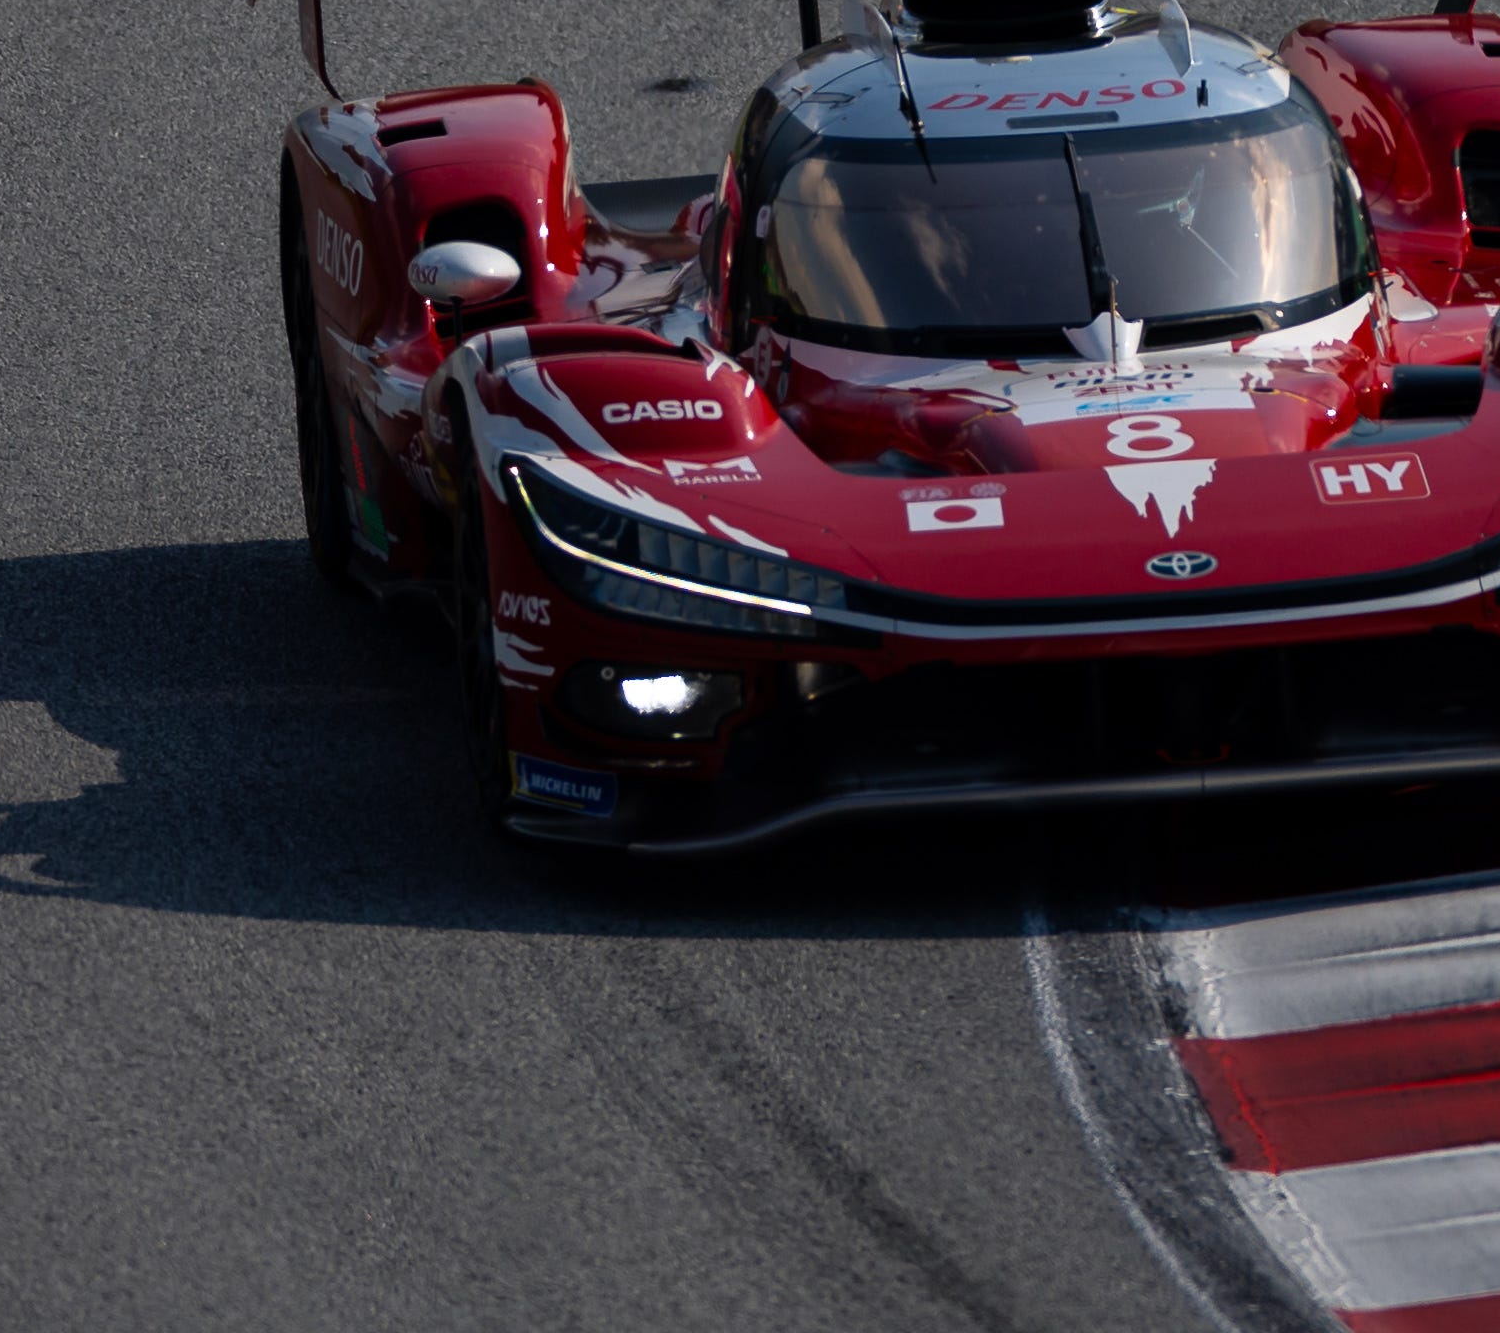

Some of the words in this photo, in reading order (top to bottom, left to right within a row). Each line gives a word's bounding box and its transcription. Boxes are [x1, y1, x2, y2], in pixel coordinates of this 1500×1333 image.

[926, 79, 1186, 111] DENSO
[317, 208, 364, 297] DENSO
[1047, 363, 1188, 380] FUJISU
[1072, 381, 1182, 397] ZENT
[602, 399, 723, 424] CASIO
[1106, 414, 1196, 459] 8
[674, 473, 762, 486] MARELLI
[1320, 460, 1411, 496] HY
[531, 772, 603, 801] MICHELIN
